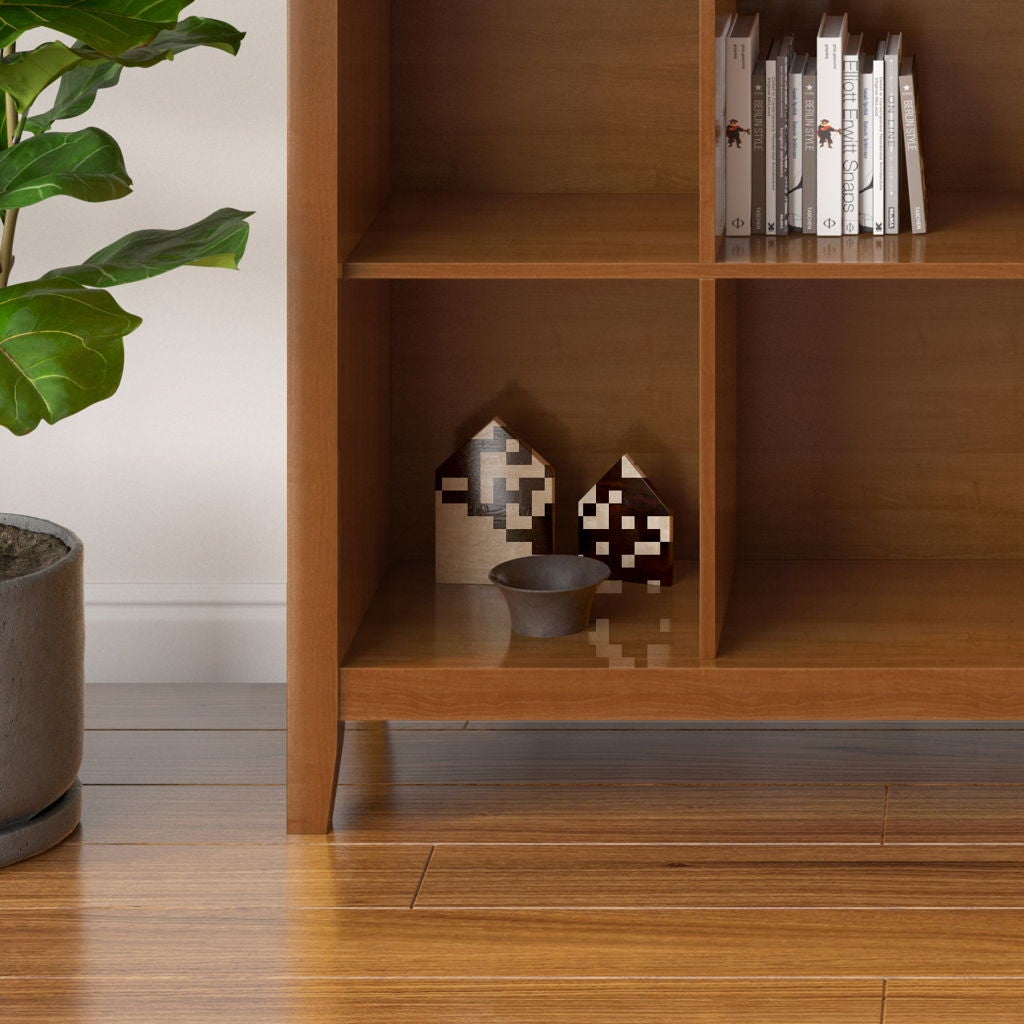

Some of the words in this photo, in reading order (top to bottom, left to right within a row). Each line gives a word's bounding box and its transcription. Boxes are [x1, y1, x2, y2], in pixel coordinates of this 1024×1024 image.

[843, 60, 858, 103] Elliott
[754, 100, 762, 127] BERLIN
[805, 100, 814, 127] BERLIN
[888, 96, 896, 113] ON
[904, 100, 914, 128] BERLIN
[754, 128, 762, 152] STYLE
[805, 128, 814, 152] STYLE
[843, 109, 858, 154] Erwitt
[888, 120, 896, 148] LINE
[906, 128, 916, 152] STYLE
[843, 160, 858, 213] Snaps
